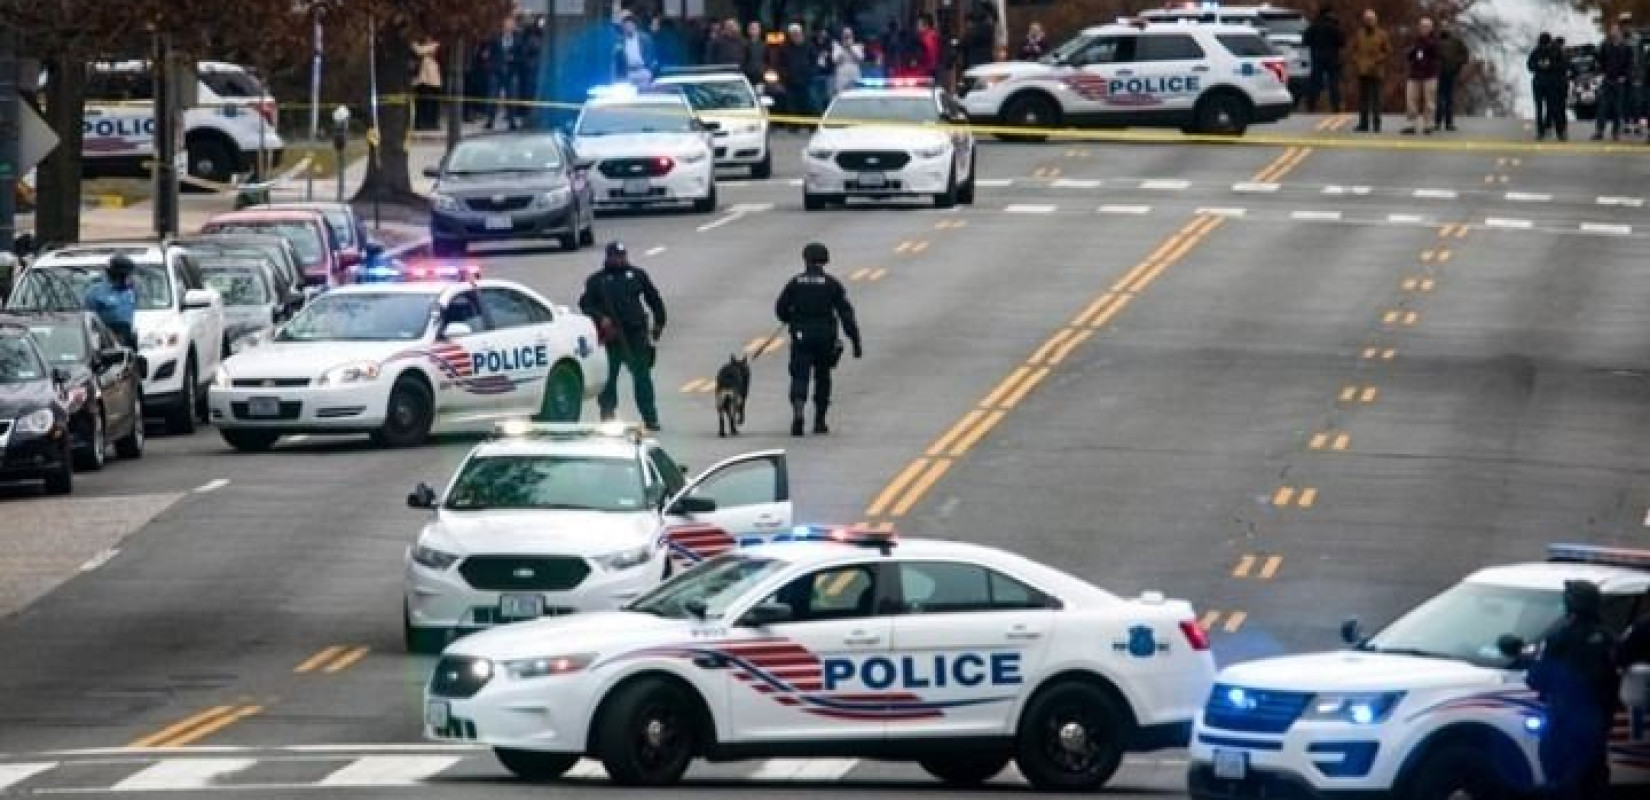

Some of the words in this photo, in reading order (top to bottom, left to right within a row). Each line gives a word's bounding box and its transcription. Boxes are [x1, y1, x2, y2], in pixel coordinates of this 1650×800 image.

[1108, 76, 1200, 94] POLICE
[473, 344, 548, 374] POLICE
[824, 652, 1023, 691] POLICE
